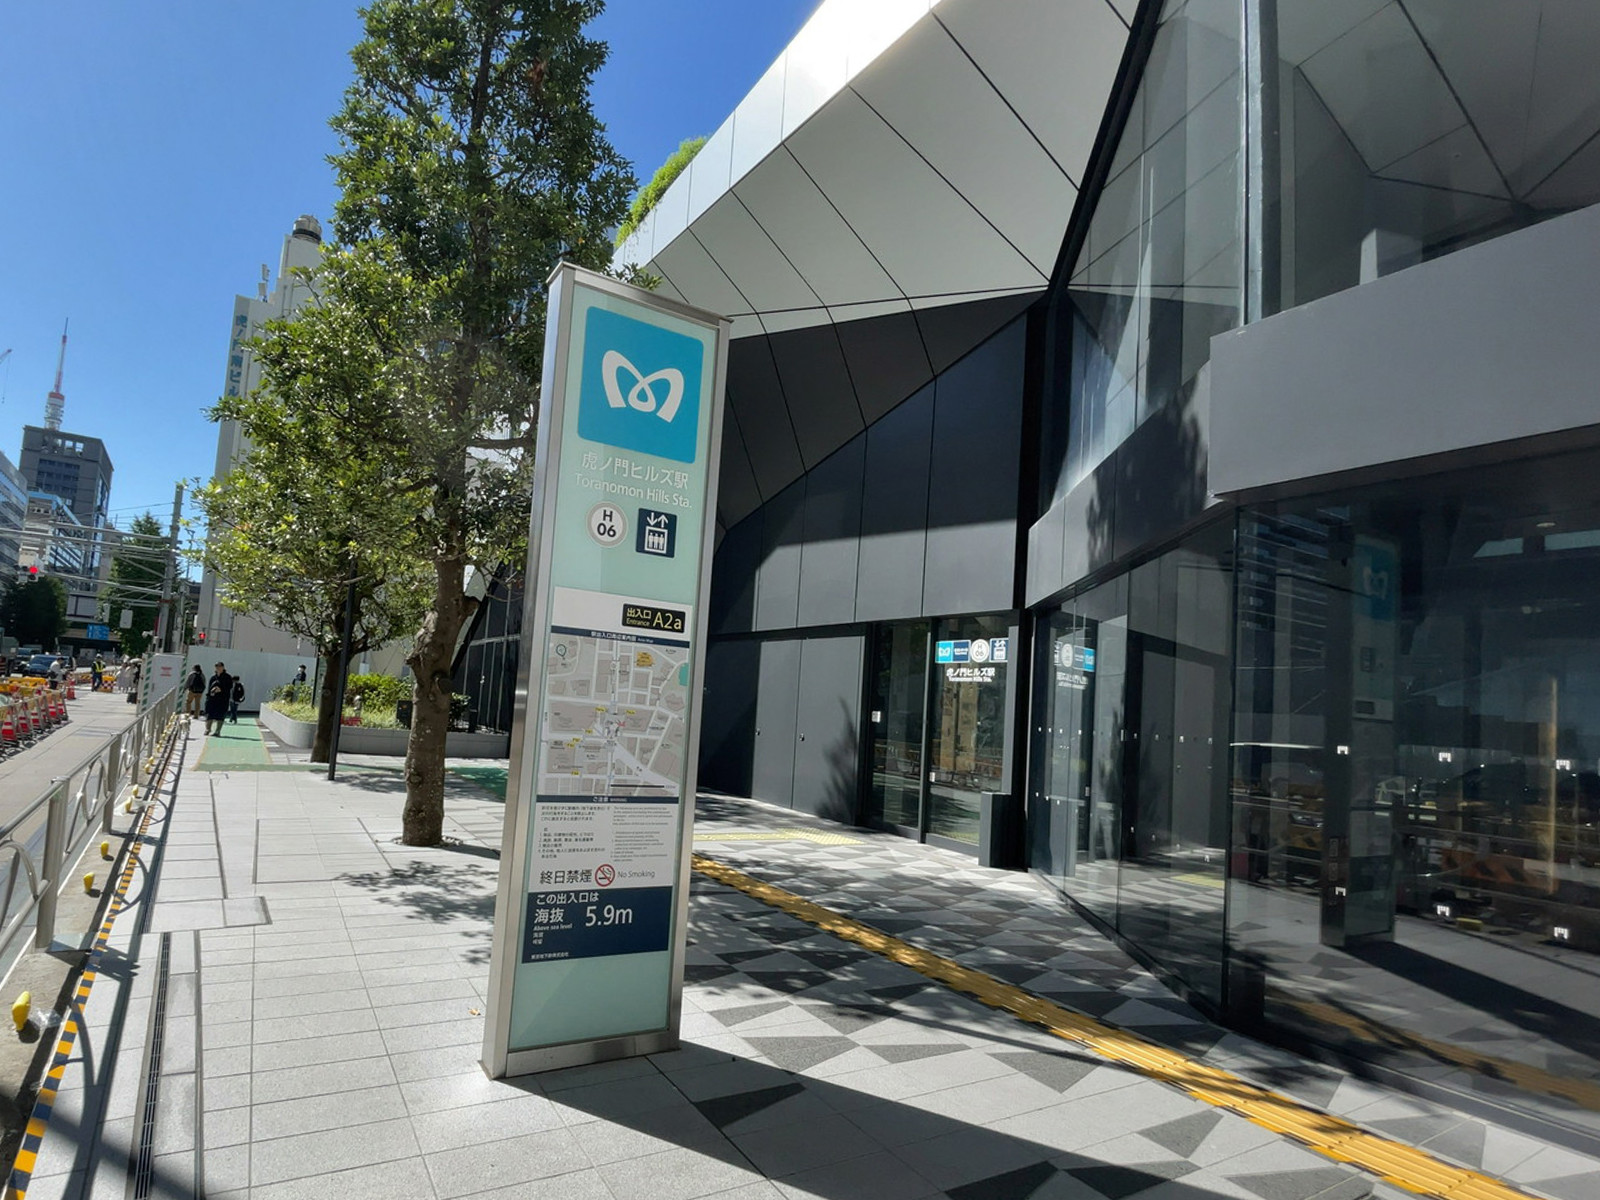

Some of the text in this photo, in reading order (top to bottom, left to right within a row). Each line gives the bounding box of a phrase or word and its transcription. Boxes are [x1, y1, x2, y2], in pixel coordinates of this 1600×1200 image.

[581, 451, 689, 490] 虎ノ門ヒルズ駅
[575, 473, 693, 508] Toranomon Hills Sta.
[602, 509, 613, 522] H
[596, 522, 617, 538] 06
[626, 607, 682, 630] 出入口 A2a
[626, 617, 651, 627] Entrance
[539, 869, 593, 885] 終日禁煙
[617, 870, 655, 880] No Smoking
[536, 892, 599, 905] この出入口は
[533, 904, 633, 927] 海抜 5.9m
